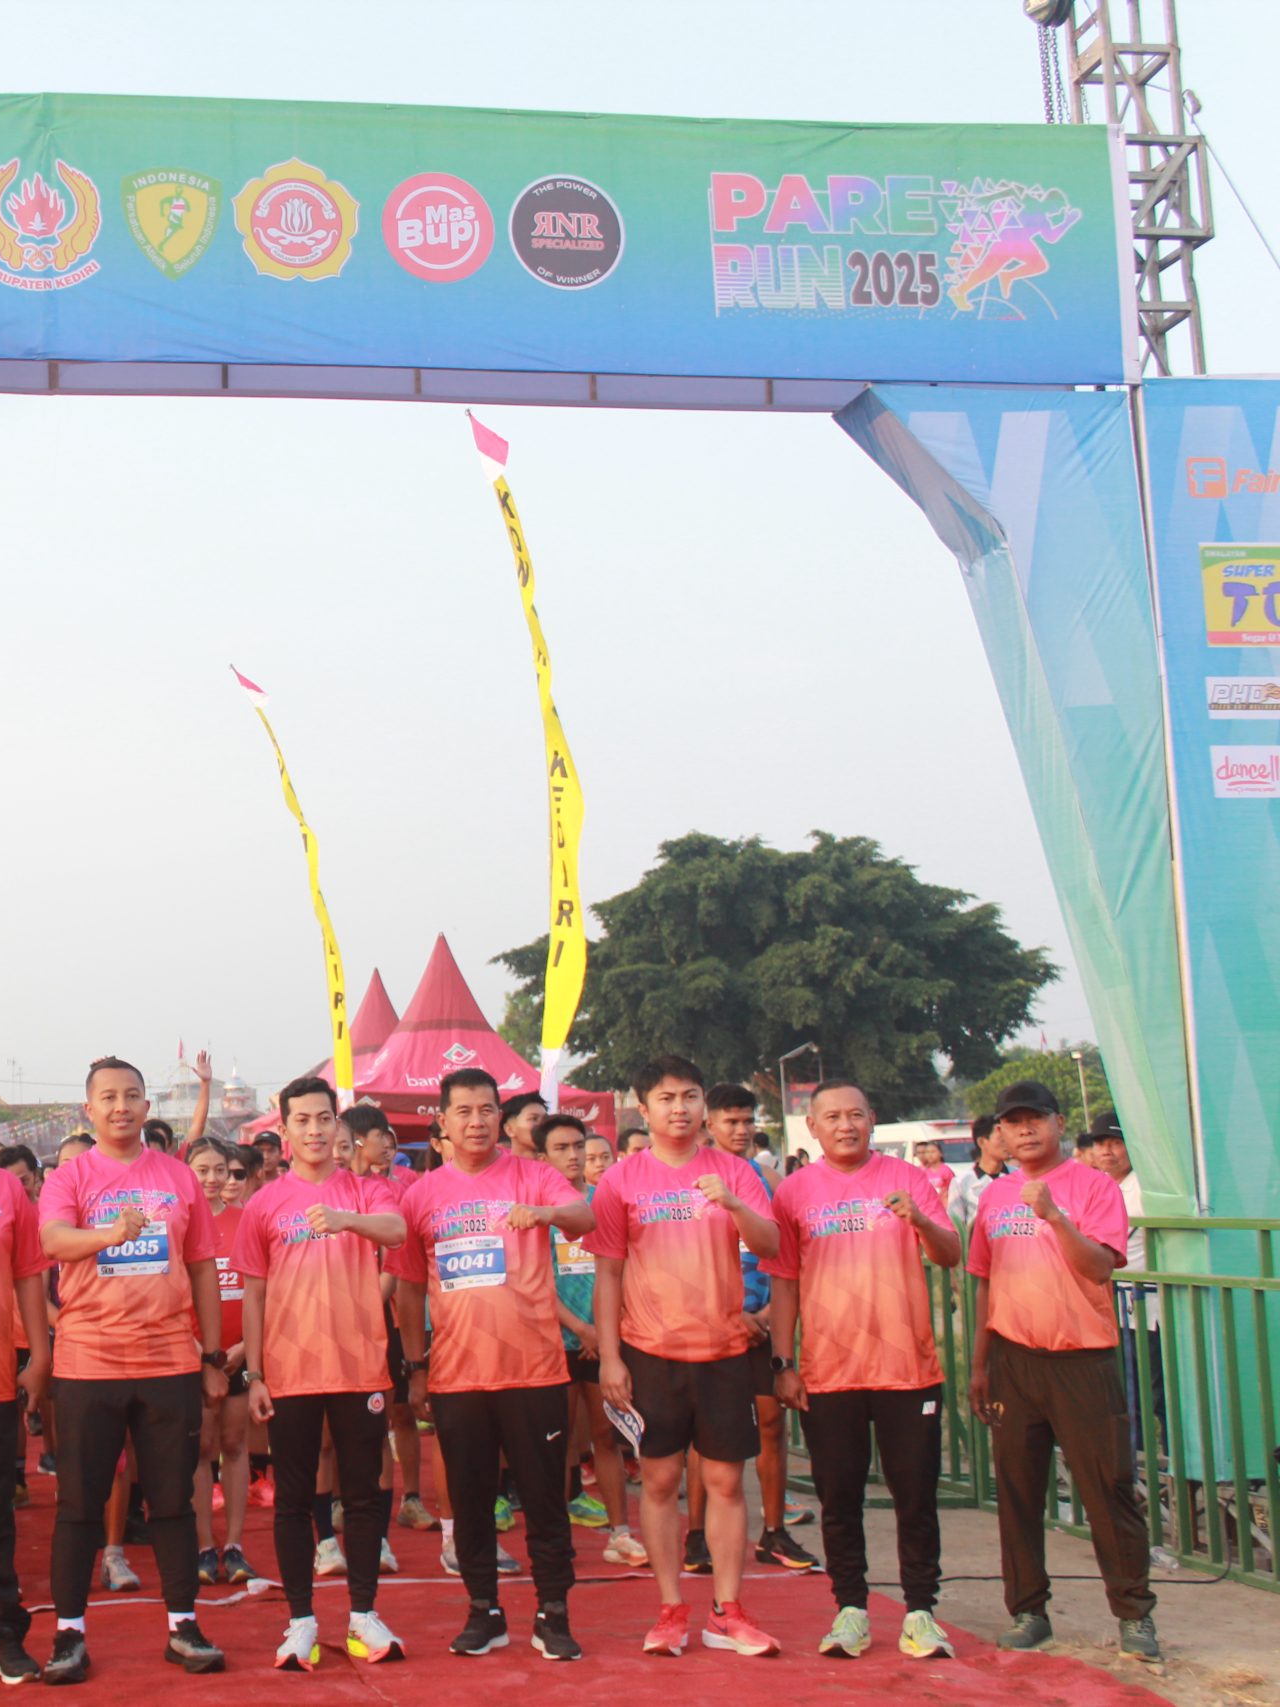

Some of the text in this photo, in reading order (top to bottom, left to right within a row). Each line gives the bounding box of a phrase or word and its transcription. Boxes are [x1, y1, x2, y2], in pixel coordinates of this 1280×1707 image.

[132, 171, 211, 192] INDONESIA
[531, 180, 599, 201] THE POWER
[710, 172, 938, 236] PARE
[425, 204, 476, 226] Mas
[397, 218, 473, 249] Bup
[531, 236, 605, 251] SPECIALIZED
[55, 261, 100, 288] KEDIRI
[536, 266, 602, 285] OF WINNER
[712, 244, 941, 310] RUN 2025
[1222, 563, 1274, 578] SUPER
[86, 1188, 144, 1208] PARE
[635, 1190, 692, 1206] PARE
[431, 1199, 488, 1223] PARE
[638, 1206, 693, 1225] RUN 2025
[806, 1199, 865, 1220] PARE
[431, 1218, 487, 1240] RUN 2025
[807, 1218, 865, 1239] RUN 2025
[106, 1239, 160, 1258] 0035
[446, 1252, 495, 1271] 0041
